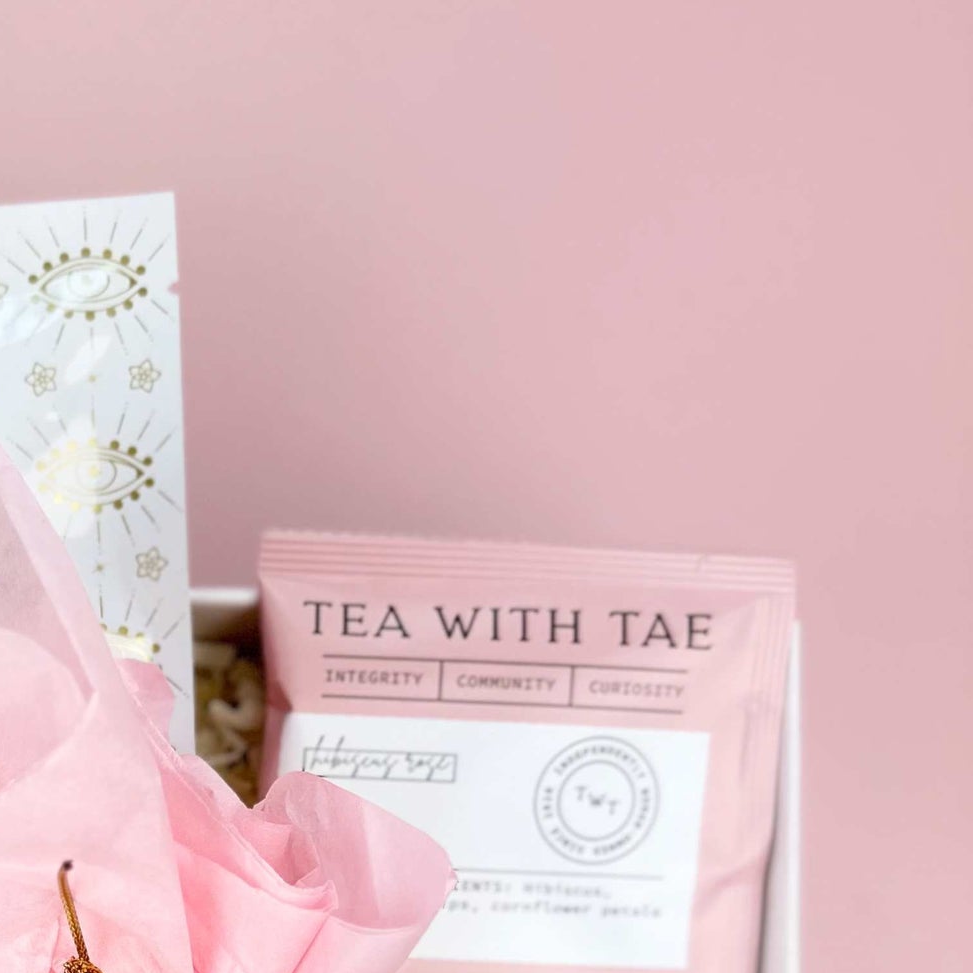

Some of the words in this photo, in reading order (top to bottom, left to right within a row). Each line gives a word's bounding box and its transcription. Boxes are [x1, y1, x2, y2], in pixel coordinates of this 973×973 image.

[304, 601, 411, 638] TEA
[434, 606, 582, 644] WITH
[609, 611, 713, 650] TAE
[325, 669, 423, 686] INTEGRITY
[457, 674, 557, 691] COMMUNITY
[589, 680, 685, 700] CURIOSITY
